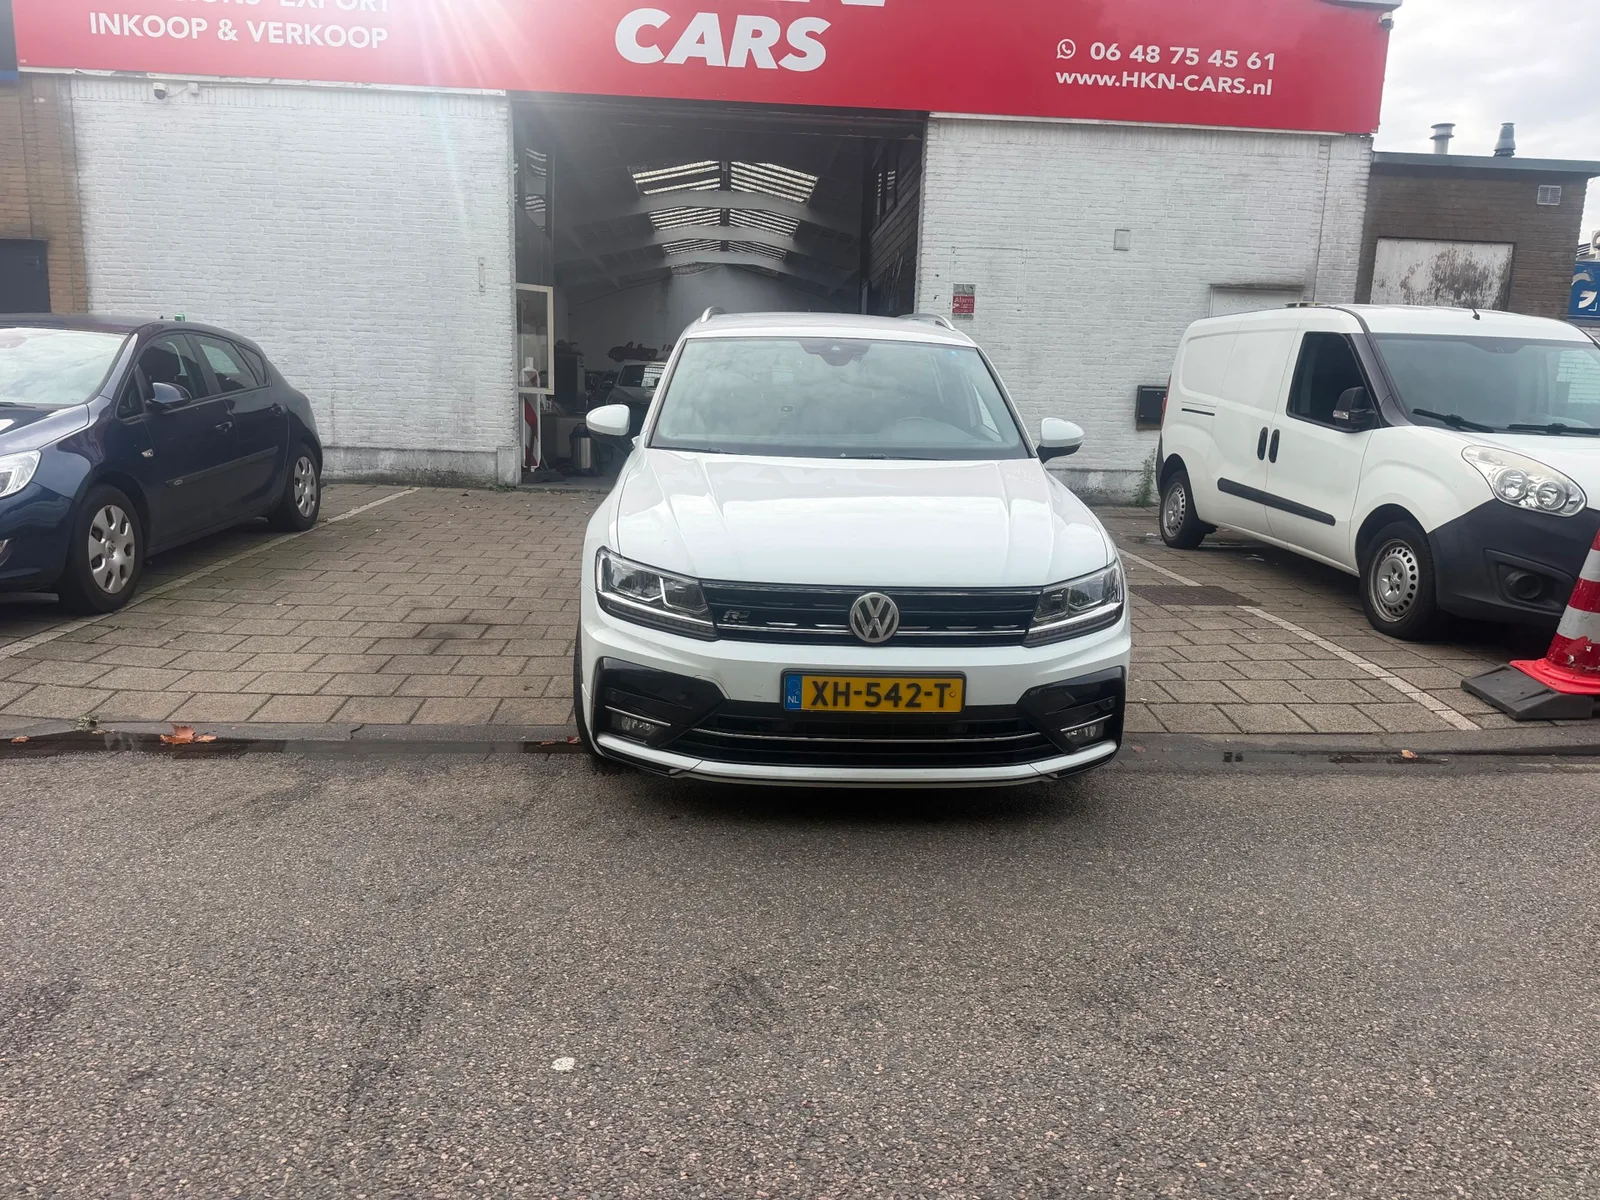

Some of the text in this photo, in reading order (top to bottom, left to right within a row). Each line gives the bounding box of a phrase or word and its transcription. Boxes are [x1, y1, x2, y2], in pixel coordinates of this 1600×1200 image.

[89, 12, 388, 49] INKOOP & VERKOOP
[615, 7, 832, 72] CARS
[1090, 42, 1275, 71] 06 48 75 45 61
[1055, 71, 1273, 96] www.HKN-CARS.nl
[787, 695, 800, 704] NL
[810, 680, 951, 708] XH-542-T
